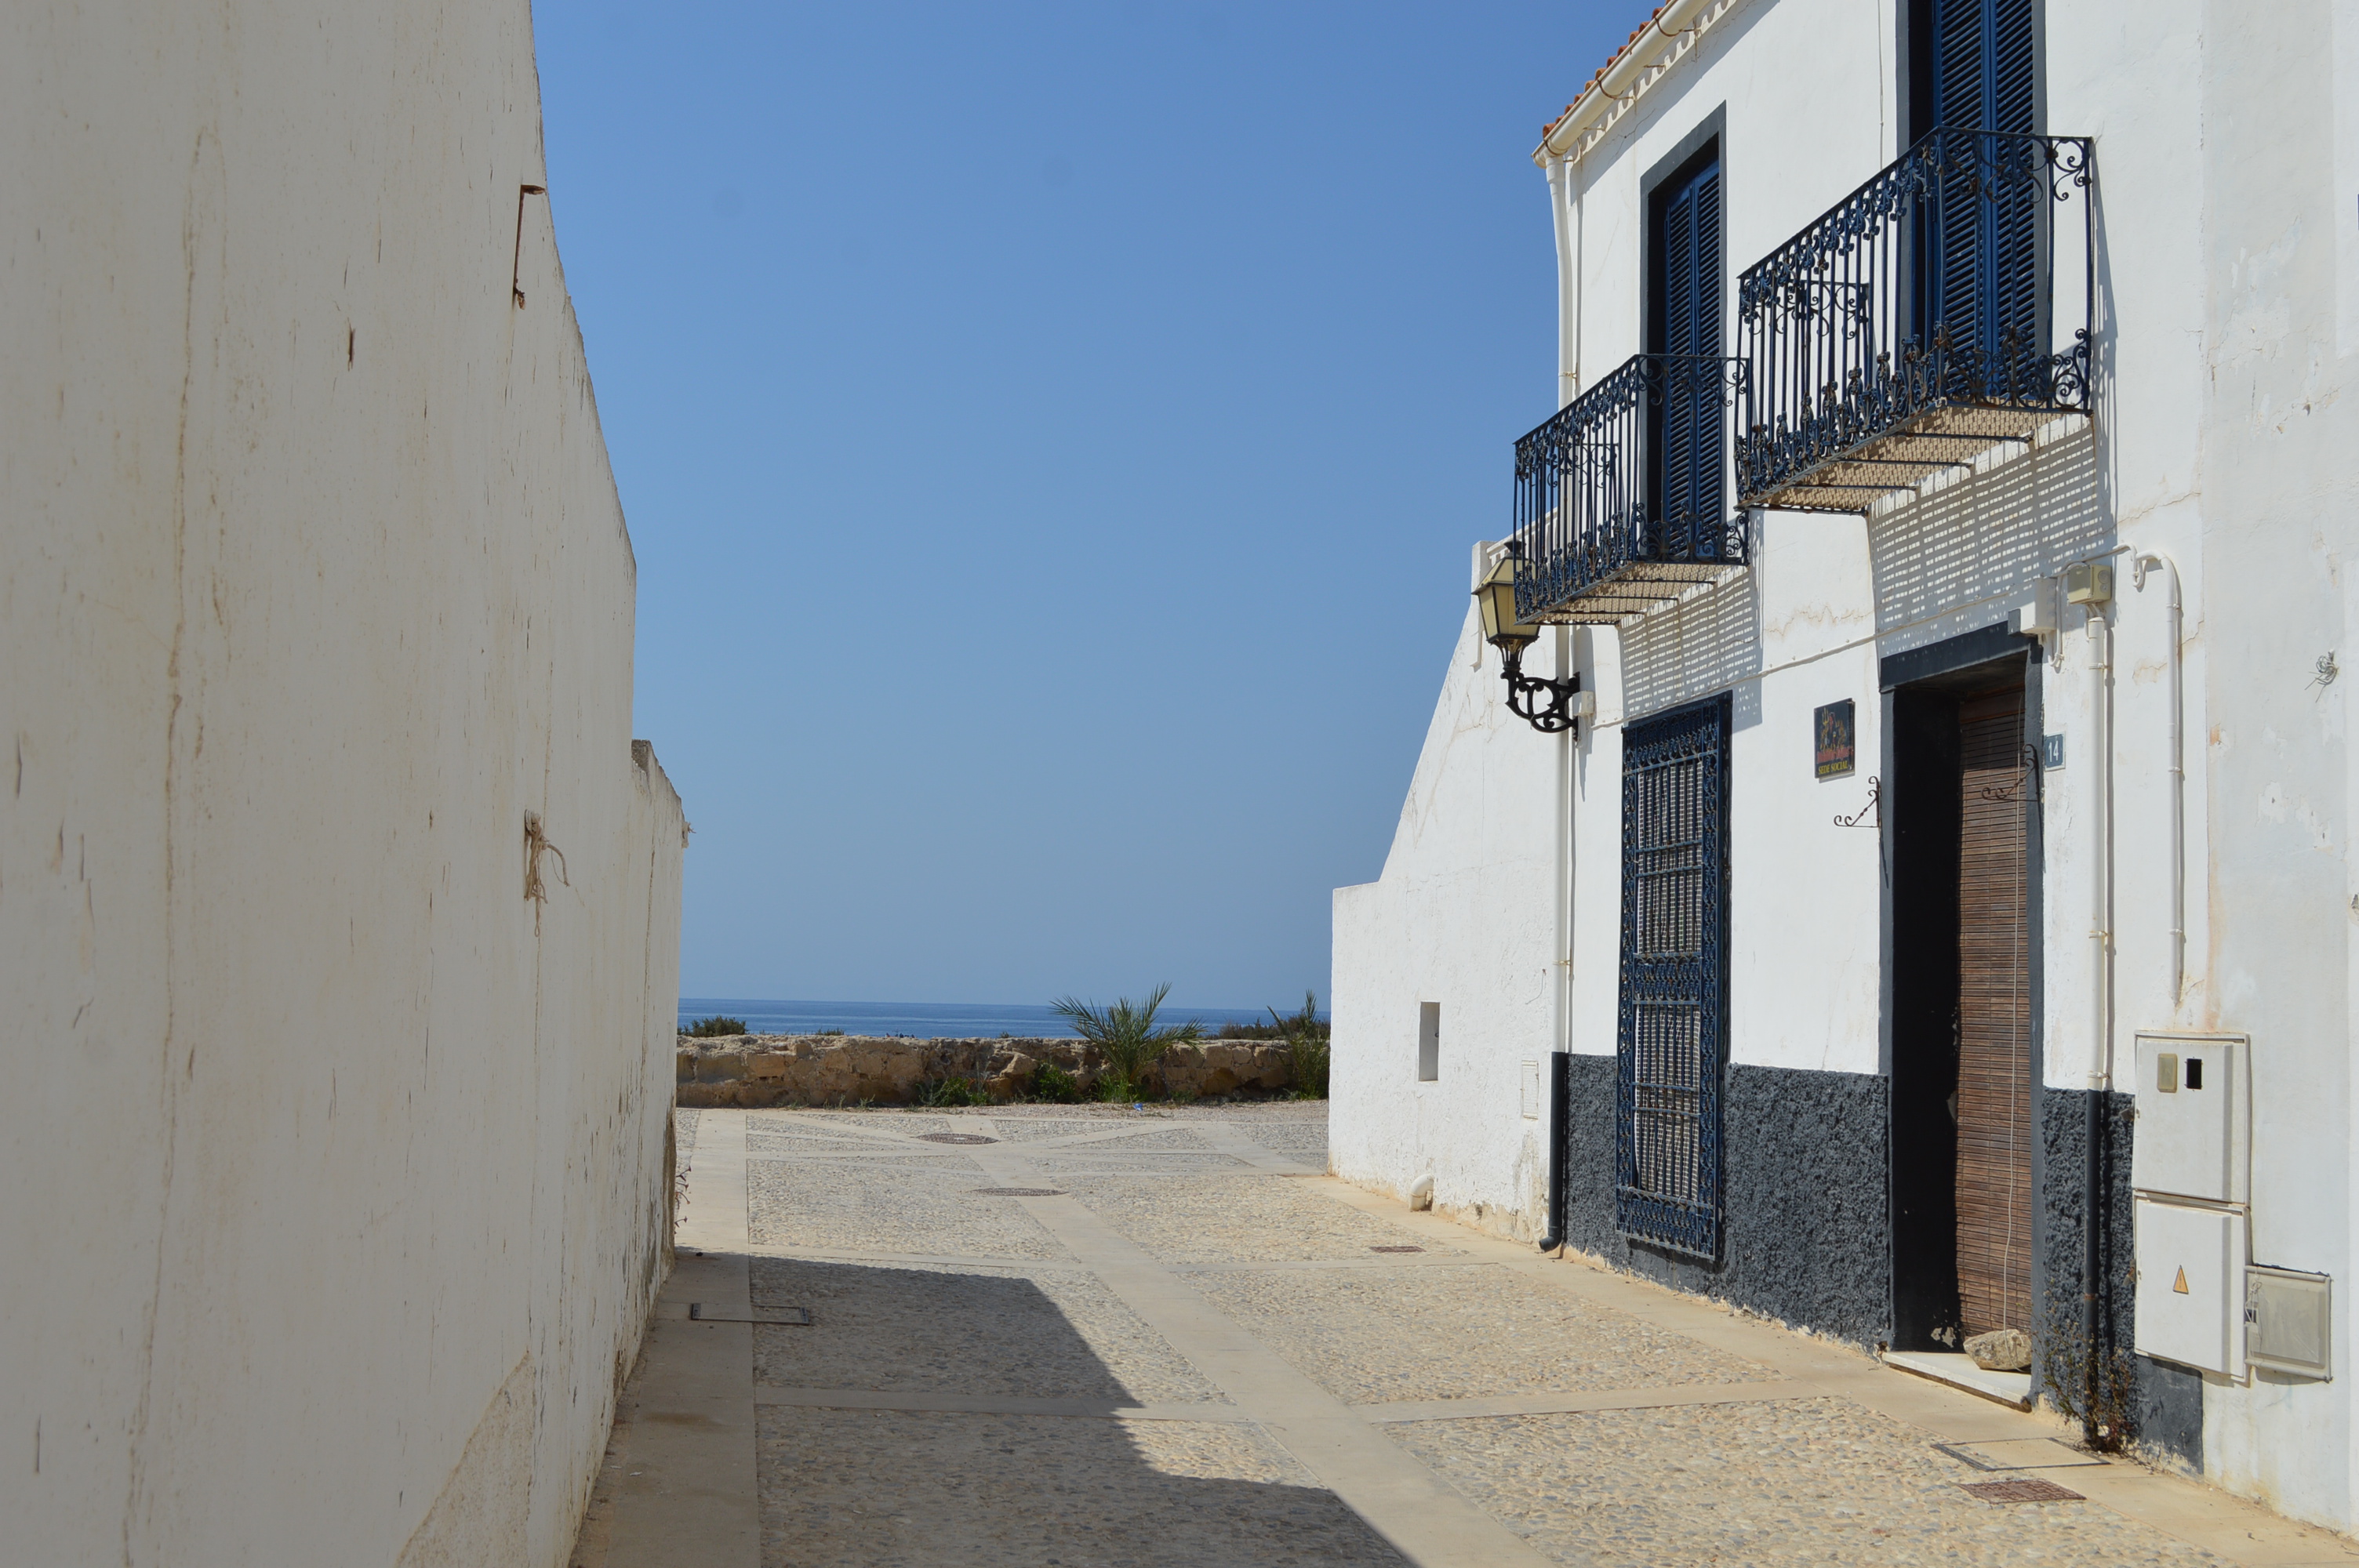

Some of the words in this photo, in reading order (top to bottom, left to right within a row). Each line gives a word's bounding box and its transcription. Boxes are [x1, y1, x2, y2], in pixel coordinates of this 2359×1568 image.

[2048, 740, 2059, 763] 14
[1819, 764, 1830, 775] SEDE
[1831, 760, 1848, 771] SOCIAL
